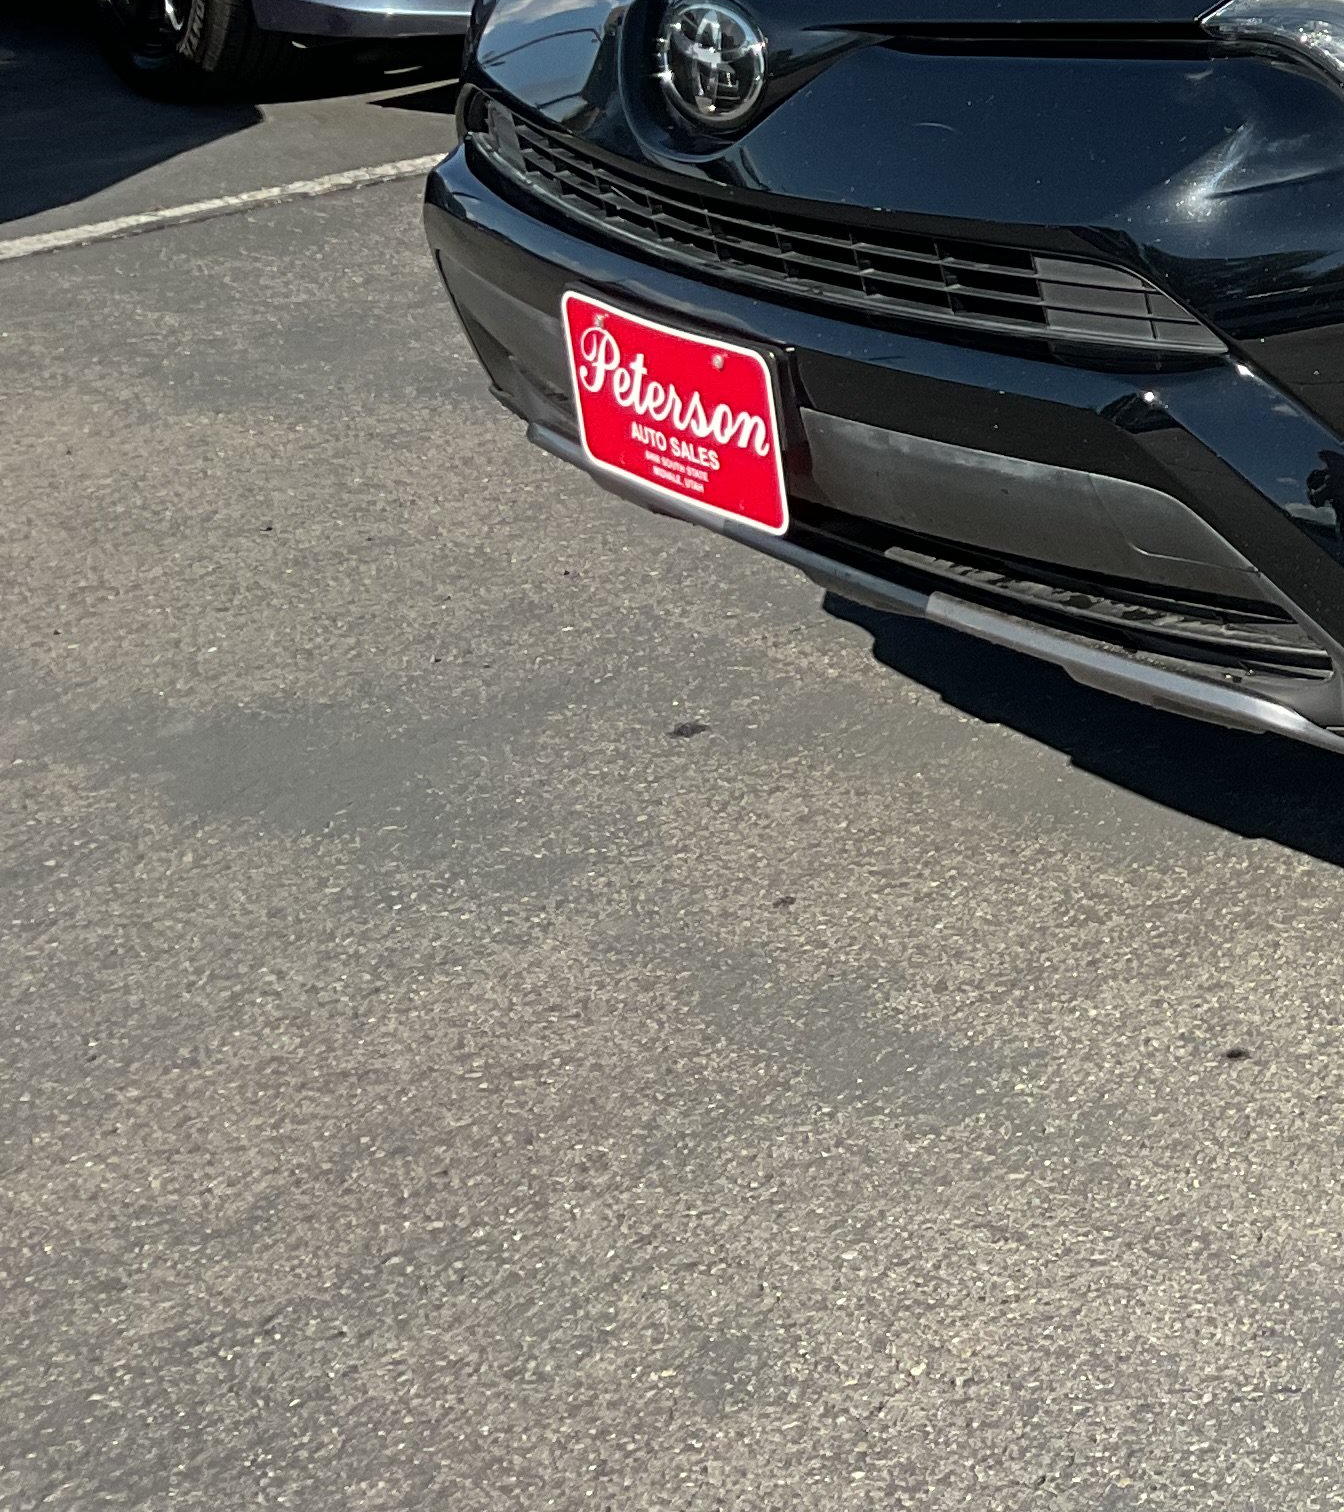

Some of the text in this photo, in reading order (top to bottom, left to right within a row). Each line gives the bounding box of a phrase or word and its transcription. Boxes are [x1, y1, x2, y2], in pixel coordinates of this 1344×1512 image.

[579, 326, 770, 457] Peterson
[631, 421, 667, 451] AUTO
[670, 437, 720, 471] SALES
